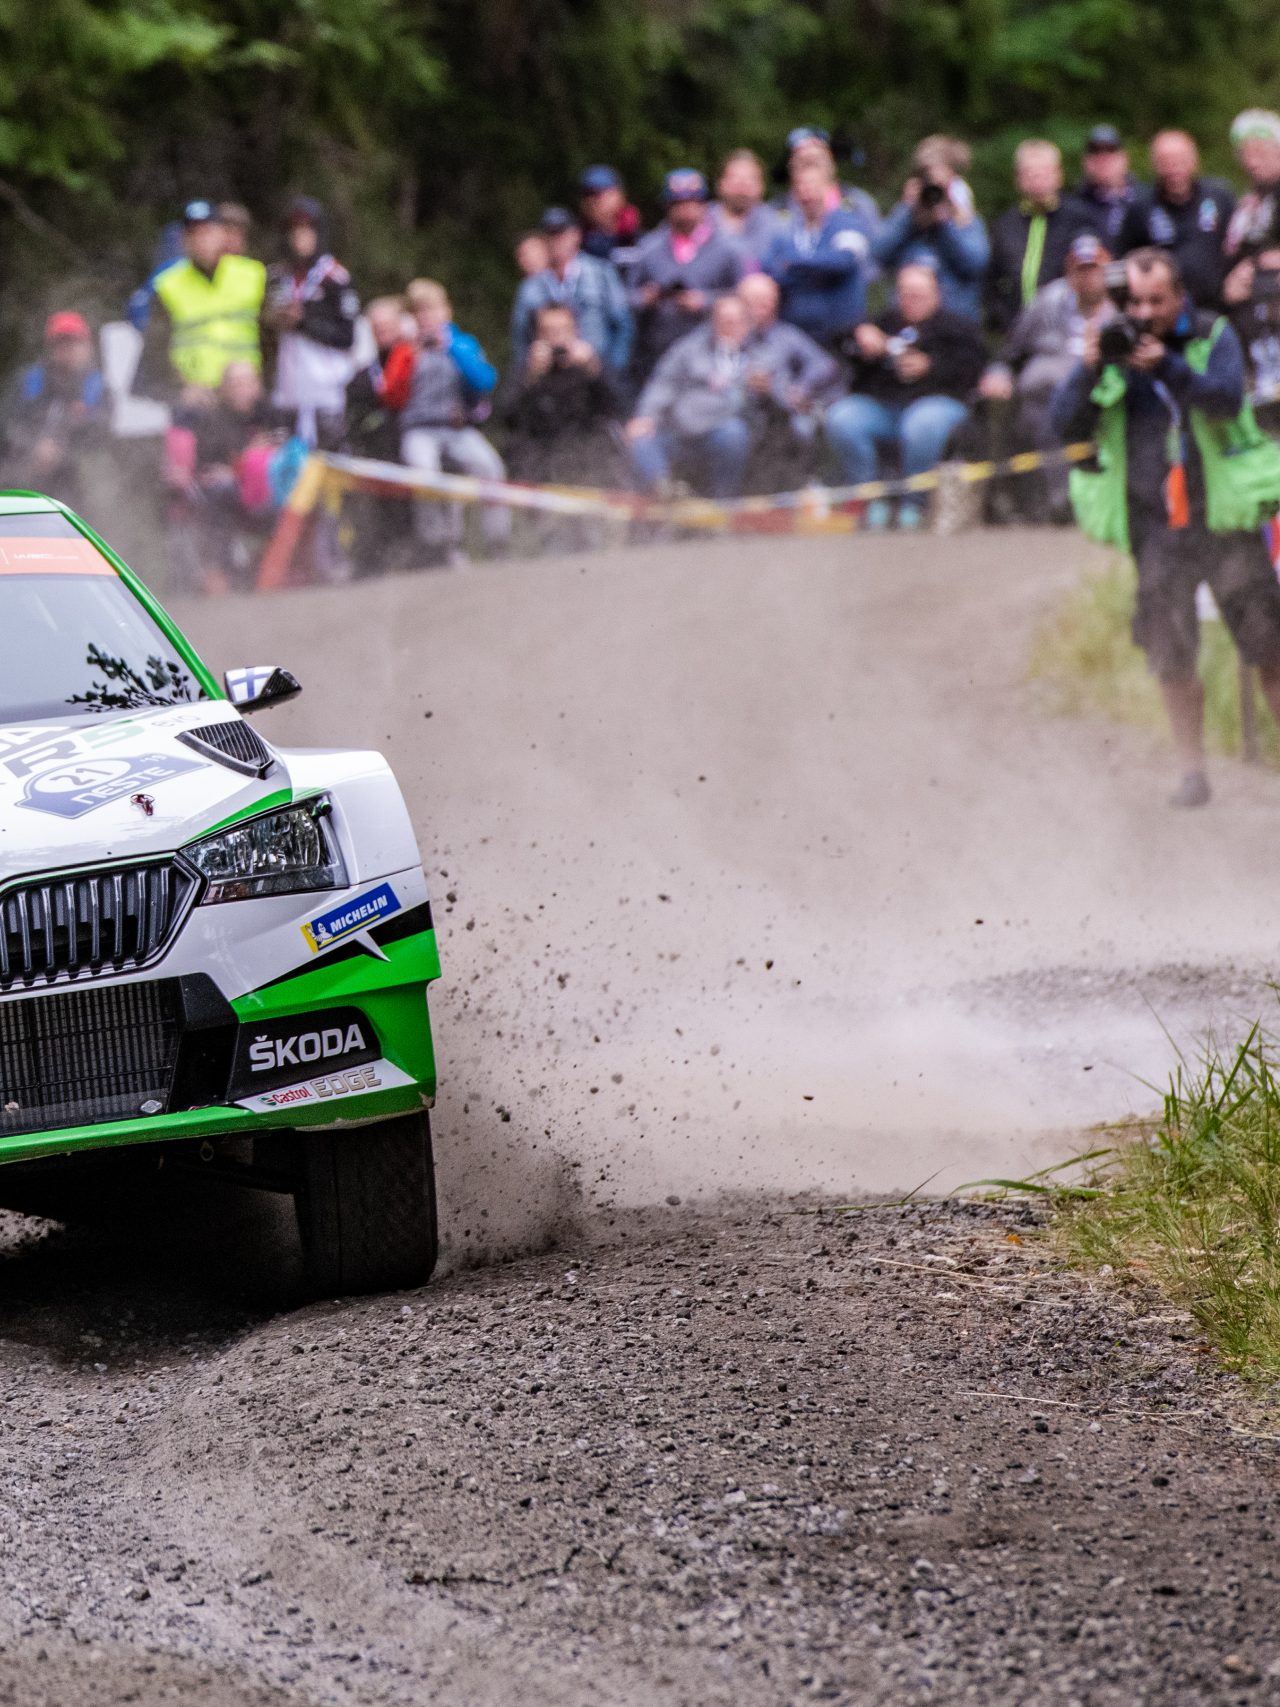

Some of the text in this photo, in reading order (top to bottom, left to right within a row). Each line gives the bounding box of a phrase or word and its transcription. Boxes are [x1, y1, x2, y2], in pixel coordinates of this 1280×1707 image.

[50, 767, 115, 786] 21
[71, 766, 176, 805] NESTE
[330, 894, 389, 934] MICHELIN
[249, 1023, 367, 1072] ŠKODA
[272, 1066, 382, 1105] Castrol EDGE
